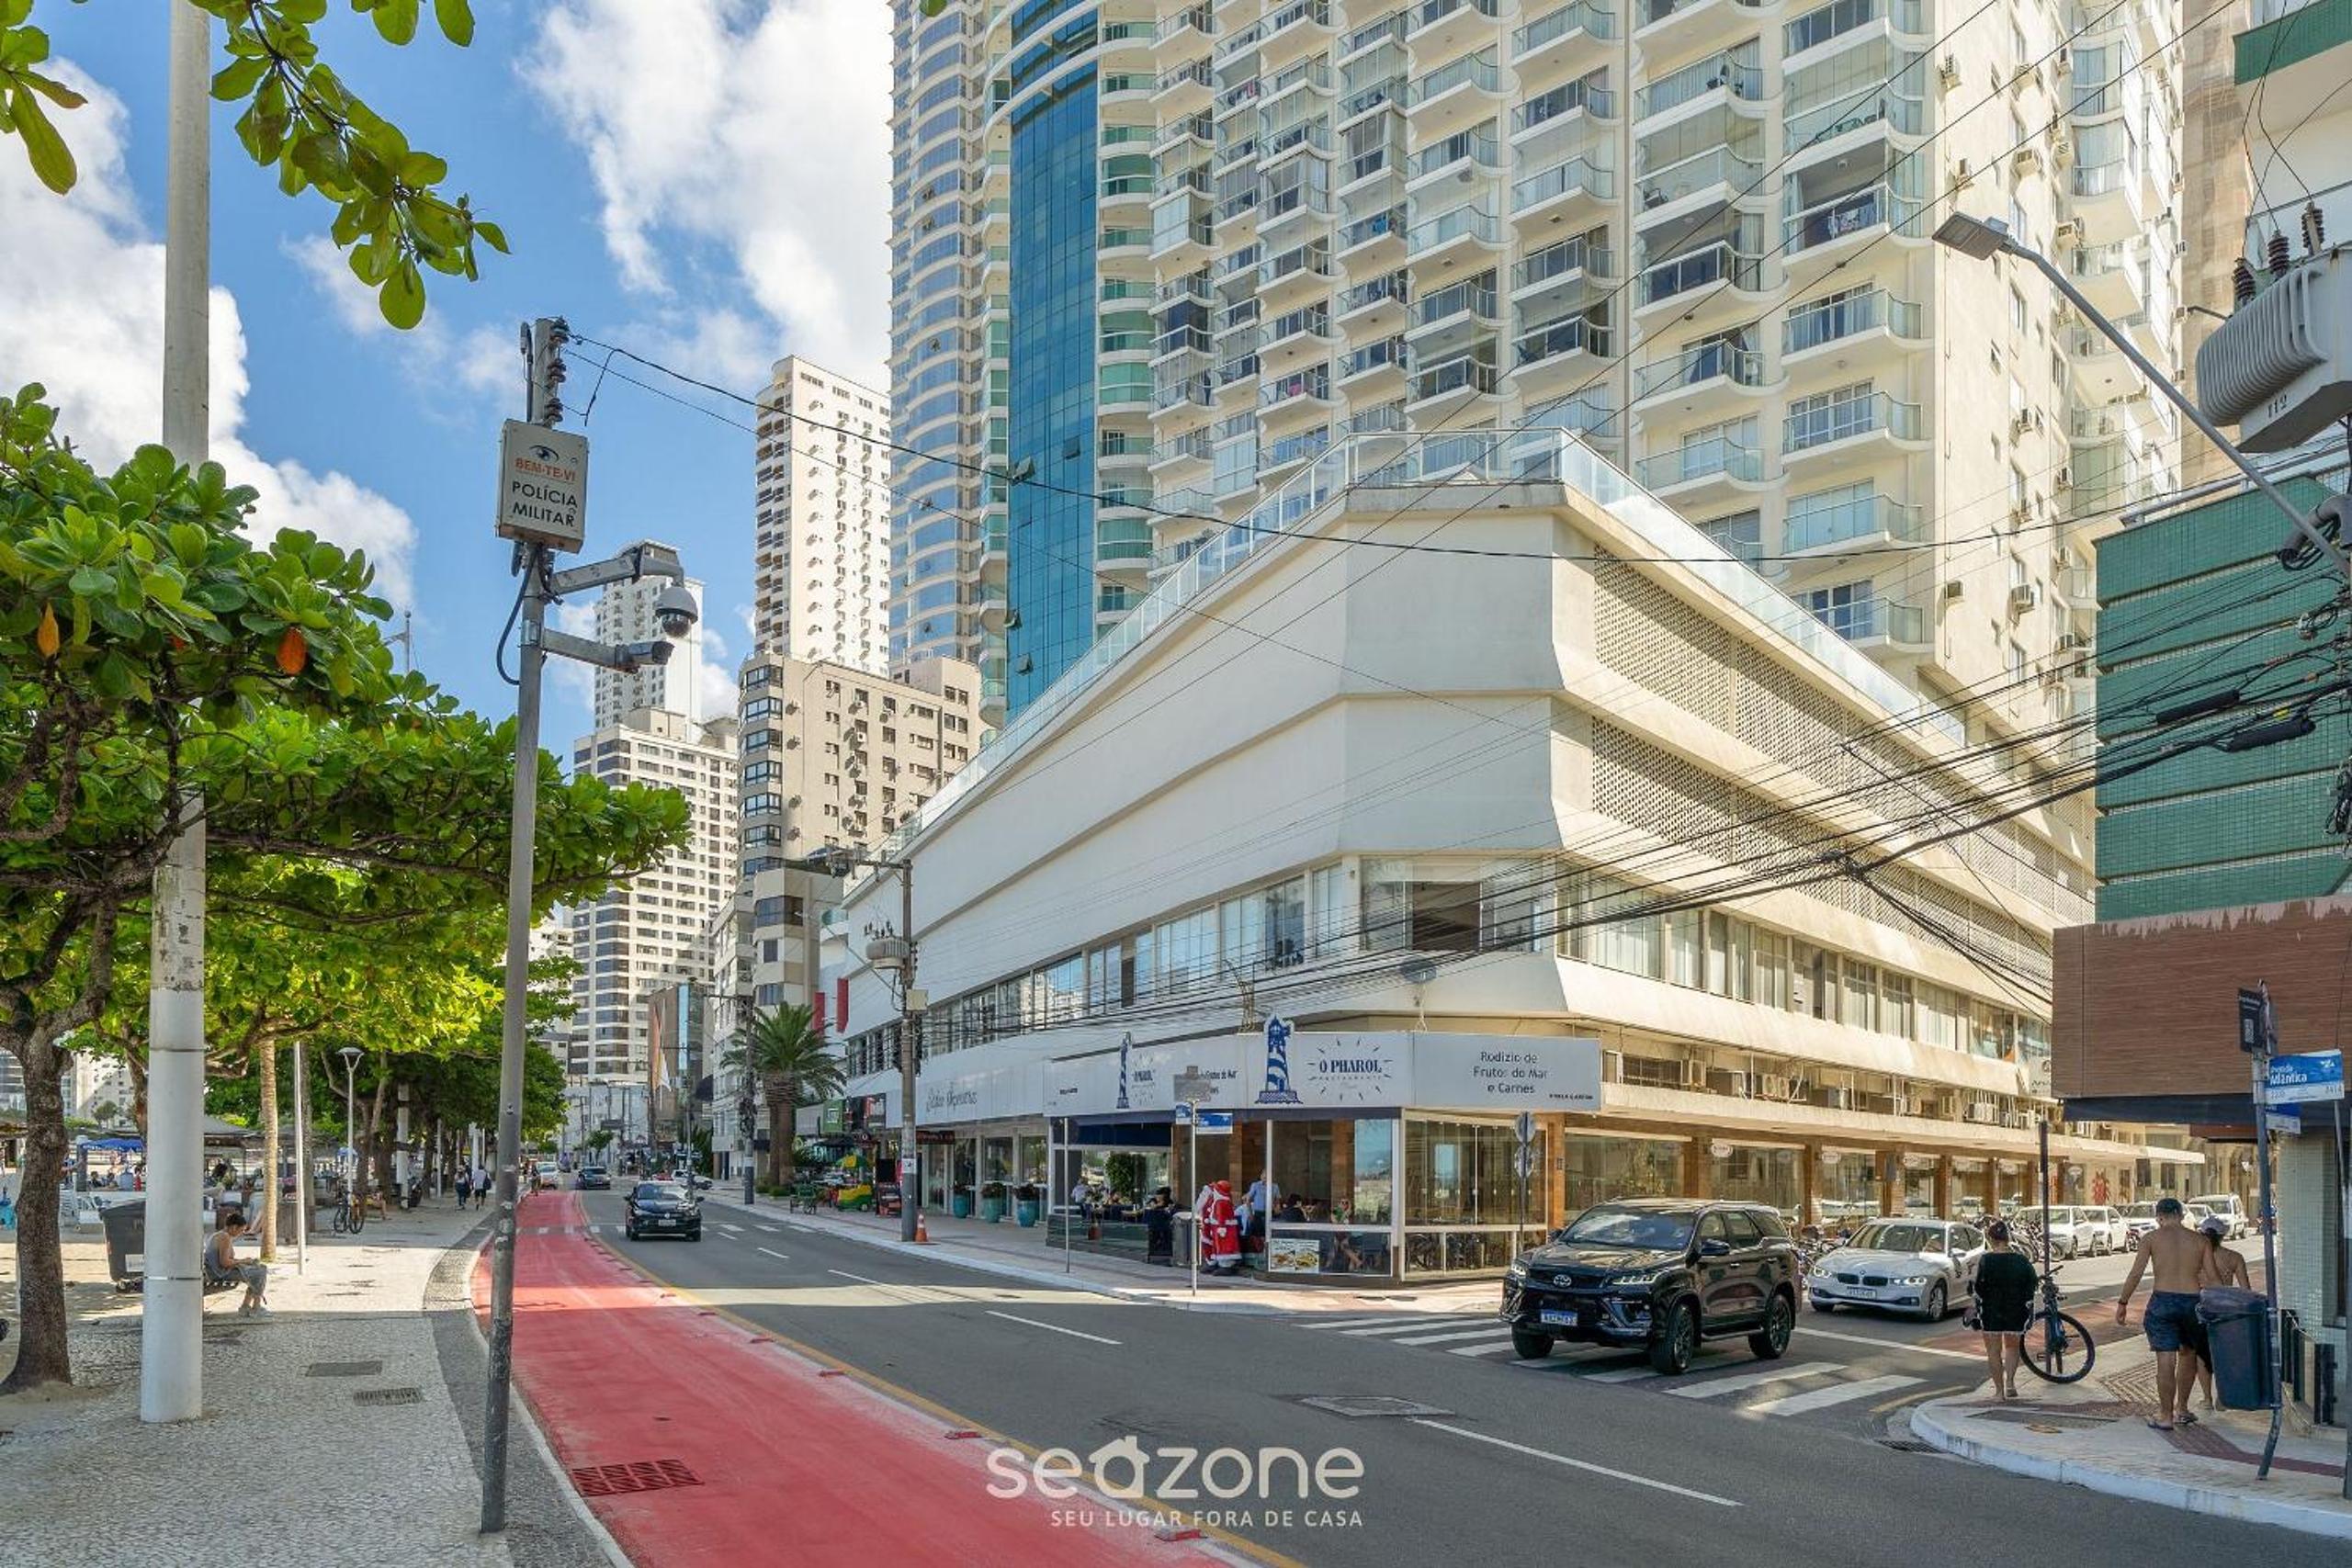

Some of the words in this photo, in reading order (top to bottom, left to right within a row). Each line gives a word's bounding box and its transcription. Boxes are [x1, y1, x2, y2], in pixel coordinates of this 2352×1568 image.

[512, 479, 578, 508] POLÍCIA
[512, 502, 575, 527] MILITAR
[1523, 1054, 1538, 1064] de
[1319, 1059, 1328, 1073] O
[1330, 1059, 1382, 1074] PHAROL
[1511, 1067, 1525, 1078] do
[1528, 1068, 1547, 1079] Mar
[1498, 1083, 1535, 1093] Carnes
